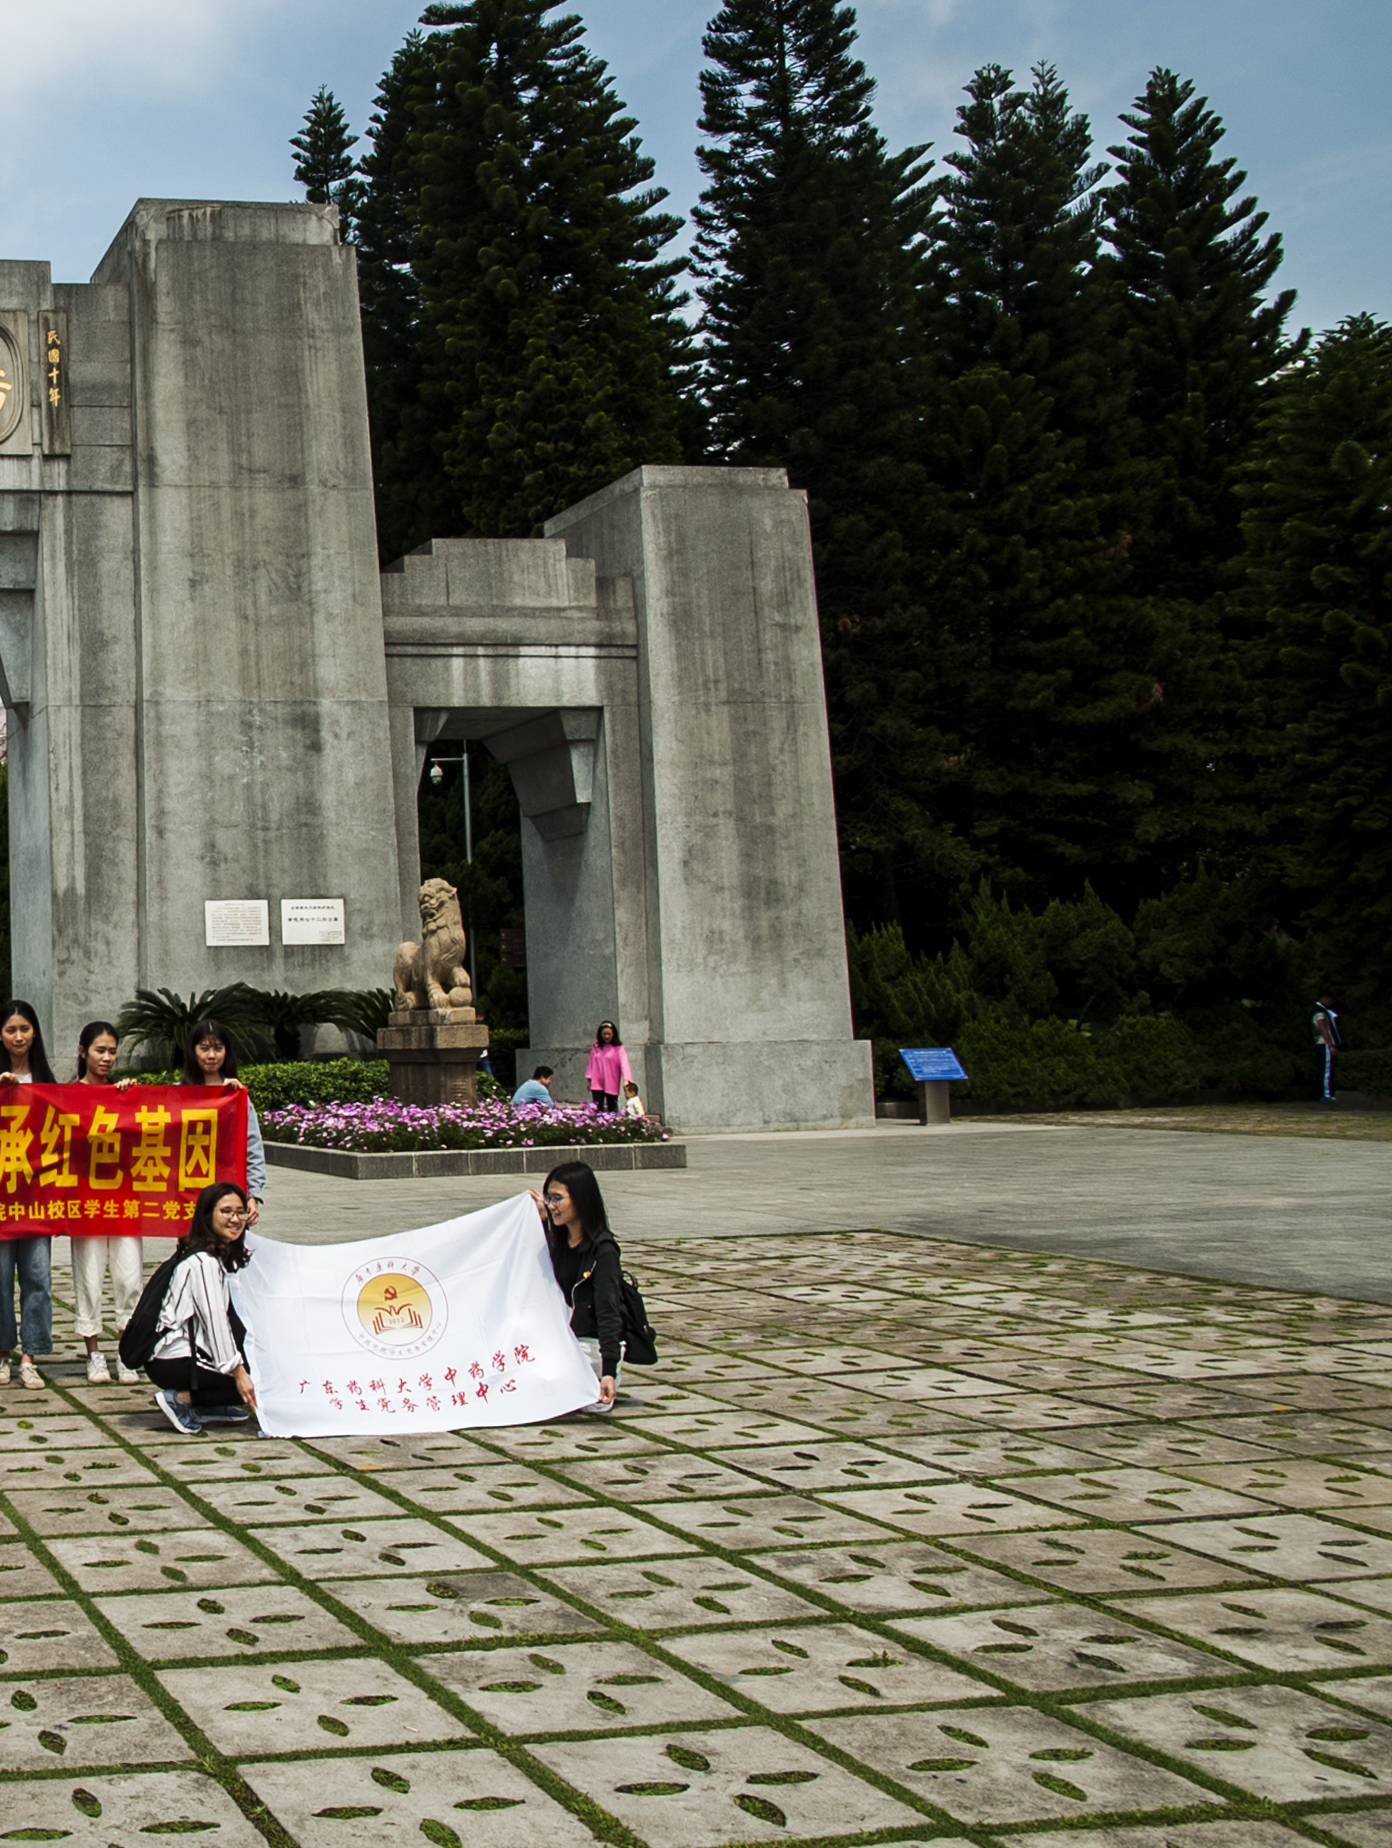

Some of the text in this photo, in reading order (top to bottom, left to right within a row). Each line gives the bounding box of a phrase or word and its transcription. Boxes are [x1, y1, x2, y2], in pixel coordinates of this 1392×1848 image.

[298, 1343, 536, 1395] 广东药科大学中药学院
[328, 1378, 518, 1414] 学生党务管理中心
